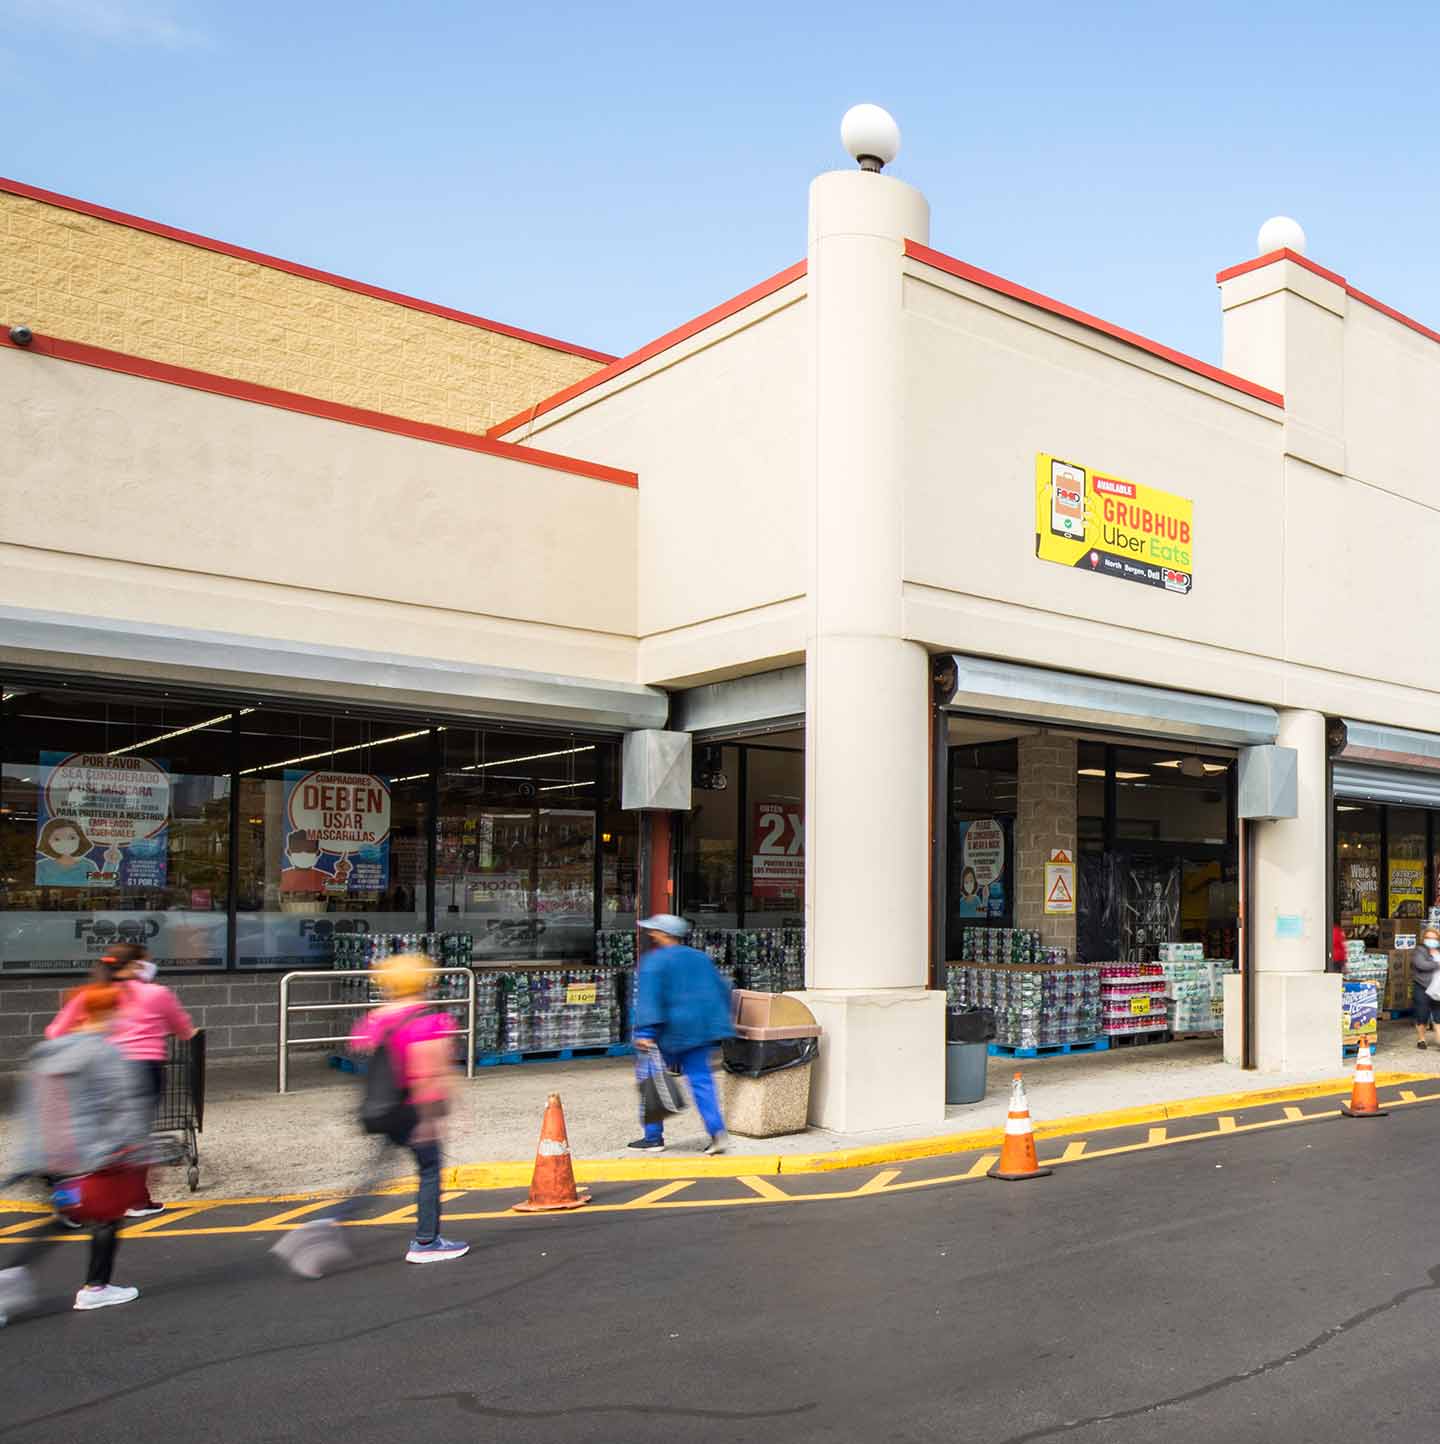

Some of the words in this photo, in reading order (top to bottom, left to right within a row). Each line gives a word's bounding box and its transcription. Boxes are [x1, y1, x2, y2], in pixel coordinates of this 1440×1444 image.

[1096, 479, 1133, 496] AVAILABLE
[1103, 498, 1191, 545] GRUBHUB
[1103, 524, 1146, 553] Uber
[1149, 537, 1191, 566] Eats
[82, 754, 105, 769] POR
[106, 756, 141, 770] FAVOR
[303, 784, 383, 814] DEBEN
[322, 811, 363, 830] USAR
[306, 828, 376, 842] MASCARILLAS
[1350, 863, 1370, 879] Wine
[1370, 863, 1378, 878] &
[74, 918, 161, 939] FOOD
[300, 918, 370, 937] FOOD
